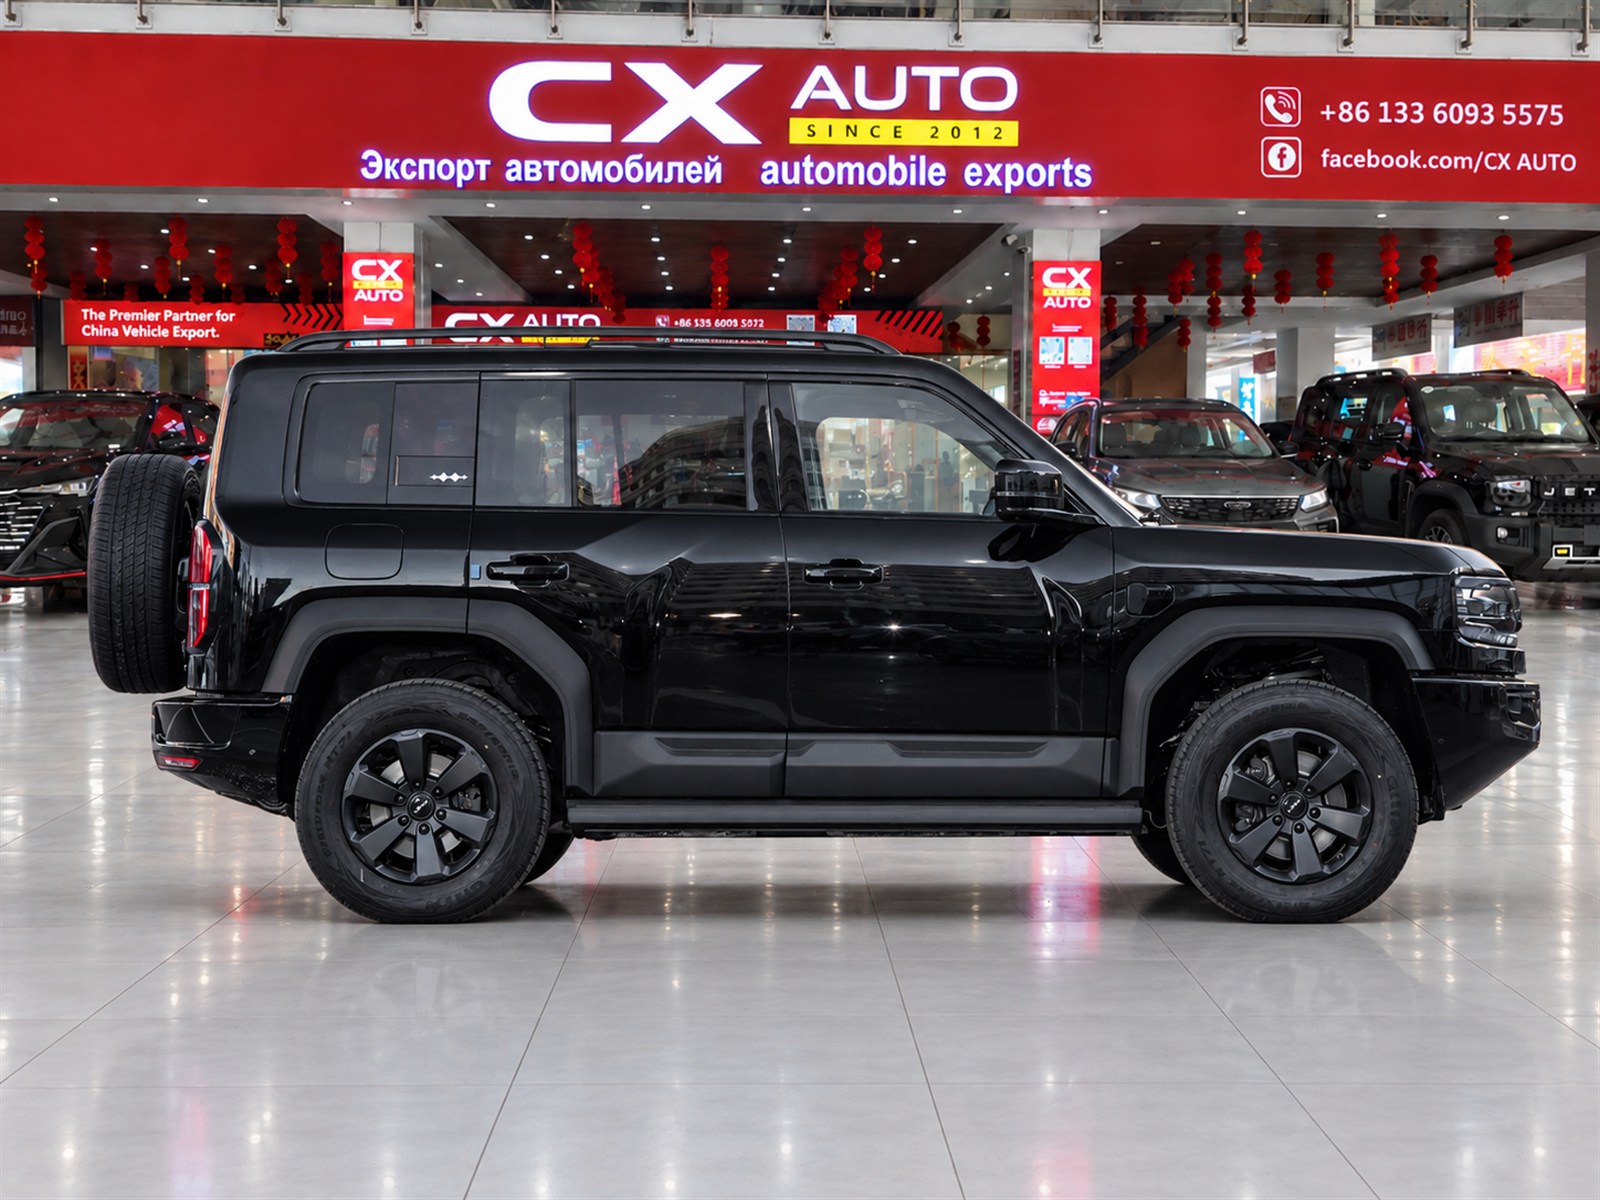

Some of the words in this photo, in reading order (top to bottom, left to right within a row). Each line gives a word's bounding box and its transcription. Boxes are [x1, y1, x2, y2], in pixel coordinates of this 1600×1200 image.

[489, 61, 763, 144] CX
[791, 65, 1019, 112] AUTO
[1321, 101, 1370, 123] +86
[1379, 102, 1425, 124] 133
[1433, 103, 1495, 125] 6093
[1503, 104, 1564, 126] 5575
[807, 124, 902, 139] SINCE
[930, 126, 1002, 140] 2012
[360, 149, 492, 187] Экспорт
[505, 153, 723, 184] автомобилей
[1321, 149, 1511, 173] facebook.com/CX
[1517, 153, 1577, 172] AUTO
[760, 154, 947, 187] automobile
[963, 157, 1092, 194] exports
[351, 259, 403, 281] CX
[1042, 267, 1092, 289] CX
[353, 289, 404, 302] AUTO
[1043, 297, 1092, 309] AUTO
[81, 308, 106, 321] The
[109, 309, 161, 322] Premier
[164, 310, 213, 322] Partner
[215, 310, 236, 322] for
[81, 324, 119, 337] China
[122, 325, 169, 338] Vehicle
[173, 326, 220, 341] Export.
[1543, 487, 1596, 497] JET
